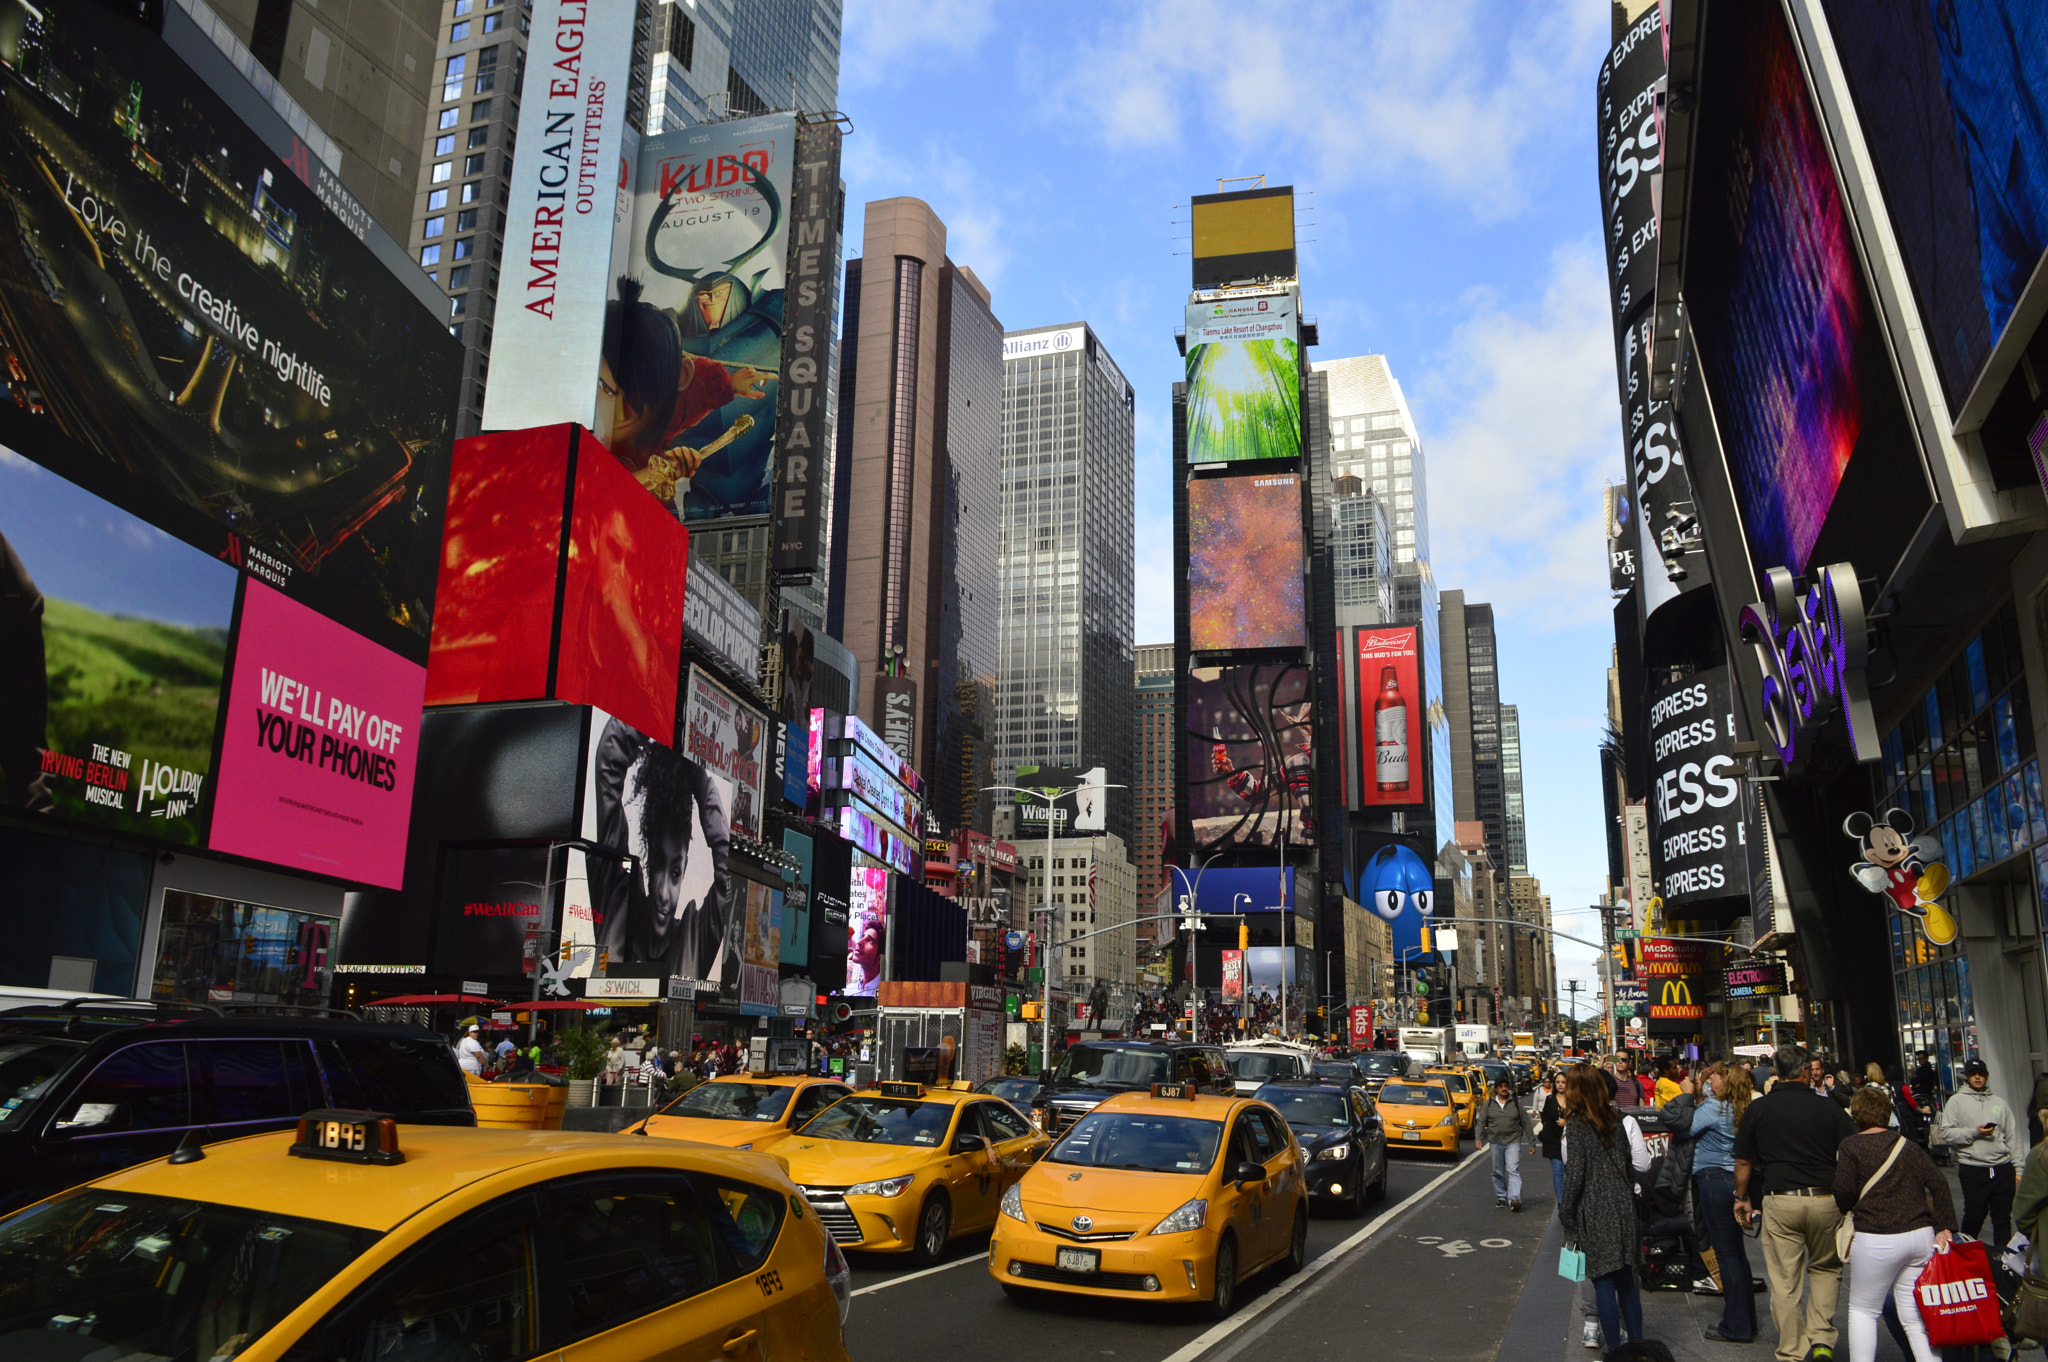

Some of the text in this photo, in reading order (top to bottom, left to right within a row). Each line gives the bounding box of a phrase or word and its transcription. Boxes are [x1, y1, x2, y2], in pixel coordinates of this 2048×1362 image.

[524, 0, 588, 321] AMERICAN EAGL
[576, 80, 606, 215] OUTFITTERS
[659, 149, 769, 200] KUBO
[319, 167, 374, 230] MARRIOTT
[677, 194, 706, 207] TWO
[315, 186, 366, 240] MARQUIS
[660, 206, 761, 231] AUGUST 19
[63, 172, 332, 407] Love the creative nightlife
[783, 161, 828, 518] TIMES SQUARE
[1202, 322, 1283, 337] Tianmu Lake Resort of Changzhou
[1003, 340, 1050, 355] Allianz
[1254, 477, 1295, 487] SAMSUNG
[248, 545, 293, 576] MARRIOTT
[781, 542, 803, 551] NYC
[247, 559, 286, 587] MARQUIS
[1367, 638, 1407, 647] Budweiser
[260, 667, 403, 755] WE'LL PAY OFF
[1651, 684, 1708, 729] EXPRESS
[256, 708, 397, 792] YOUR PHONES
[774, 721, 788, 781] NEW
[1655, 718, 1717, 762] EXPRESS
[92, 743, 132, 769] THE NEW
[687, 721, 726, 771] SCHOOL
[731, 748, 760, 791] ROCK
[41, 749, 128, 792] IRVING BERLIN
[85, 784, 124, 810] MUSICAL
[166, 799, 188, 820] INN
[1663, 824, 1727, 862] EXPRESS
[1665, 863, 1725, 898] EXPRESS
[464, 902, 539, 916] #WeAllCan
[568, 904, 604, 924] #WeAllCan
[298, 921, 332, 989] T
[1222, 957, 1242, 970] JERSEY
[605, 980, 640, 993] S'WICH
[1225, 969, 1239, 980] BOYS
[970, 985, 1002, 1003] VIRGIL'S
[1730, 986, 1753, 997] CAMERA
[1355, 1008, 1369, 1035] tkts
[1161, 1086, 1181, 1097] 6J87
[315, 1120, 366, 1151] 1893
[756, 1269, 783, 1297] 1893
[1920, 1277, 1989, 1307] OMG
